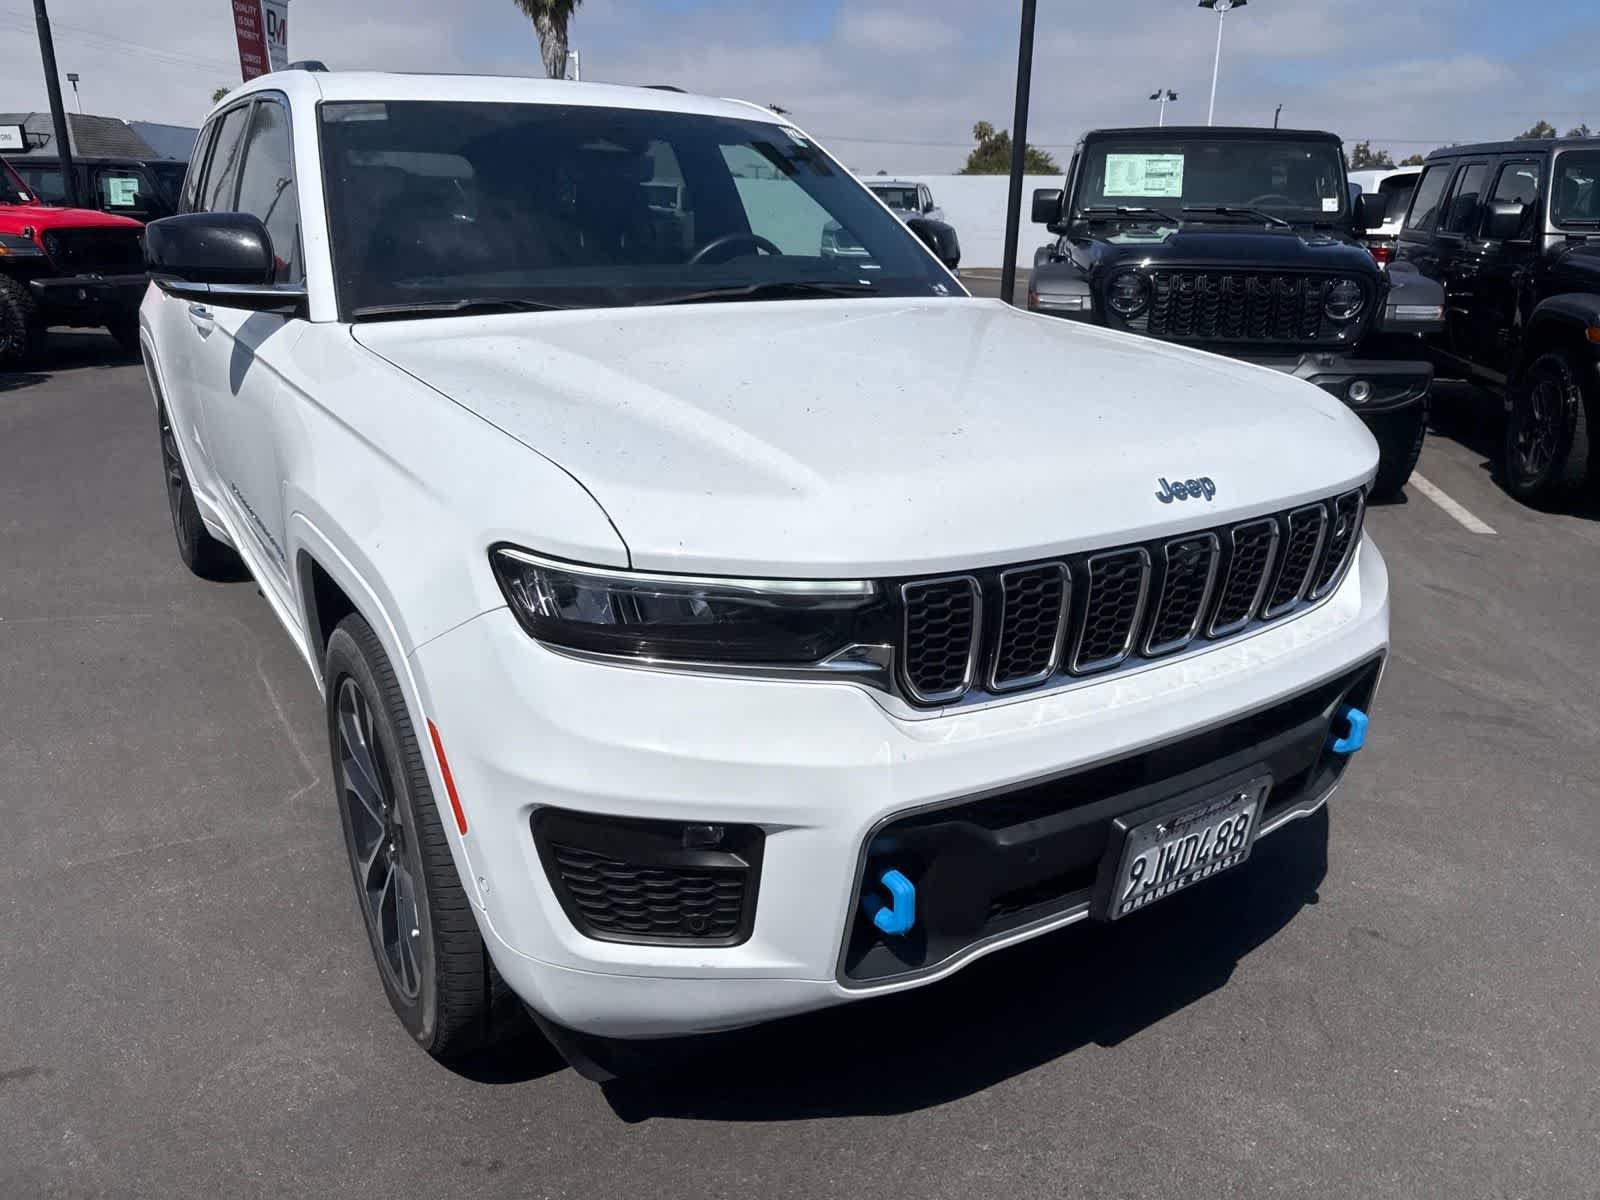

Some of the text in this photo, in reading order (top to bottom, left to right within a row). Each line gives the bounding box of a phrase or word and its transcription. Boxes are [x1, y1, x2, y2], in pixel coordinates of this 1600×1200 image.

[234, 1, 257, 16] QUALITY
[238, 28, 260, 40] PRIORITY
[1155, 477, 1216, 503] Jeep
[1122, 811, 1249, 900] 9JWD488
[1121, 852, 1243, 913] ORANGE COAST
